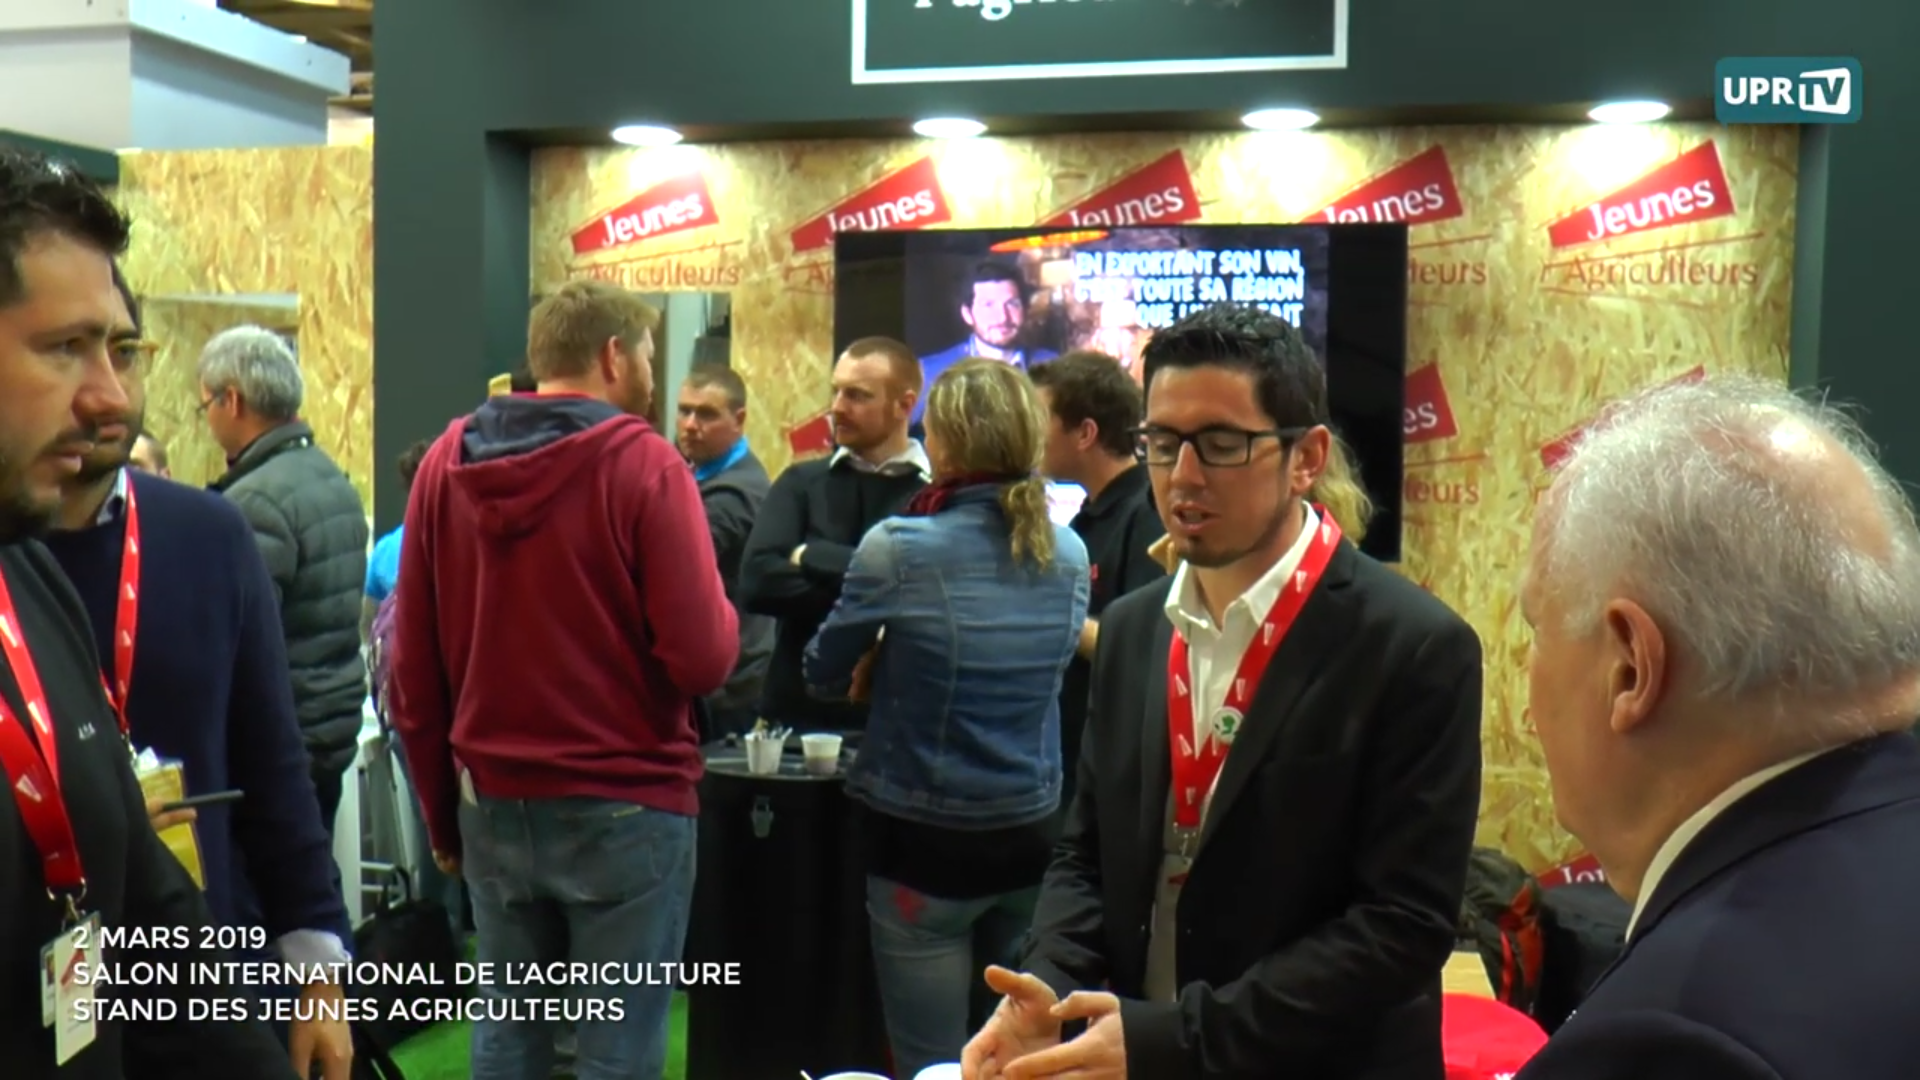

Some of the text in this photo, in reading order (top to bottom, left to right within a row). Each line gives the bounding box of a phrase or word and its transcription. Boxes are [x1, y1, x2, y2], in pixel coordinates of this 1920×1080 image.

[601, 192, 704, 247] Jeunes
[1587, 179, 1715, 240] Jeunes
[1219, 250, 1262, 274] SON
[1567, 252, 1759, 291] Agriculteurs
[1132, 277, 1195, 302] TOUTE
[1199, 277, 1229, 302] SA
[1135, 303, 1174, 329] QUE
